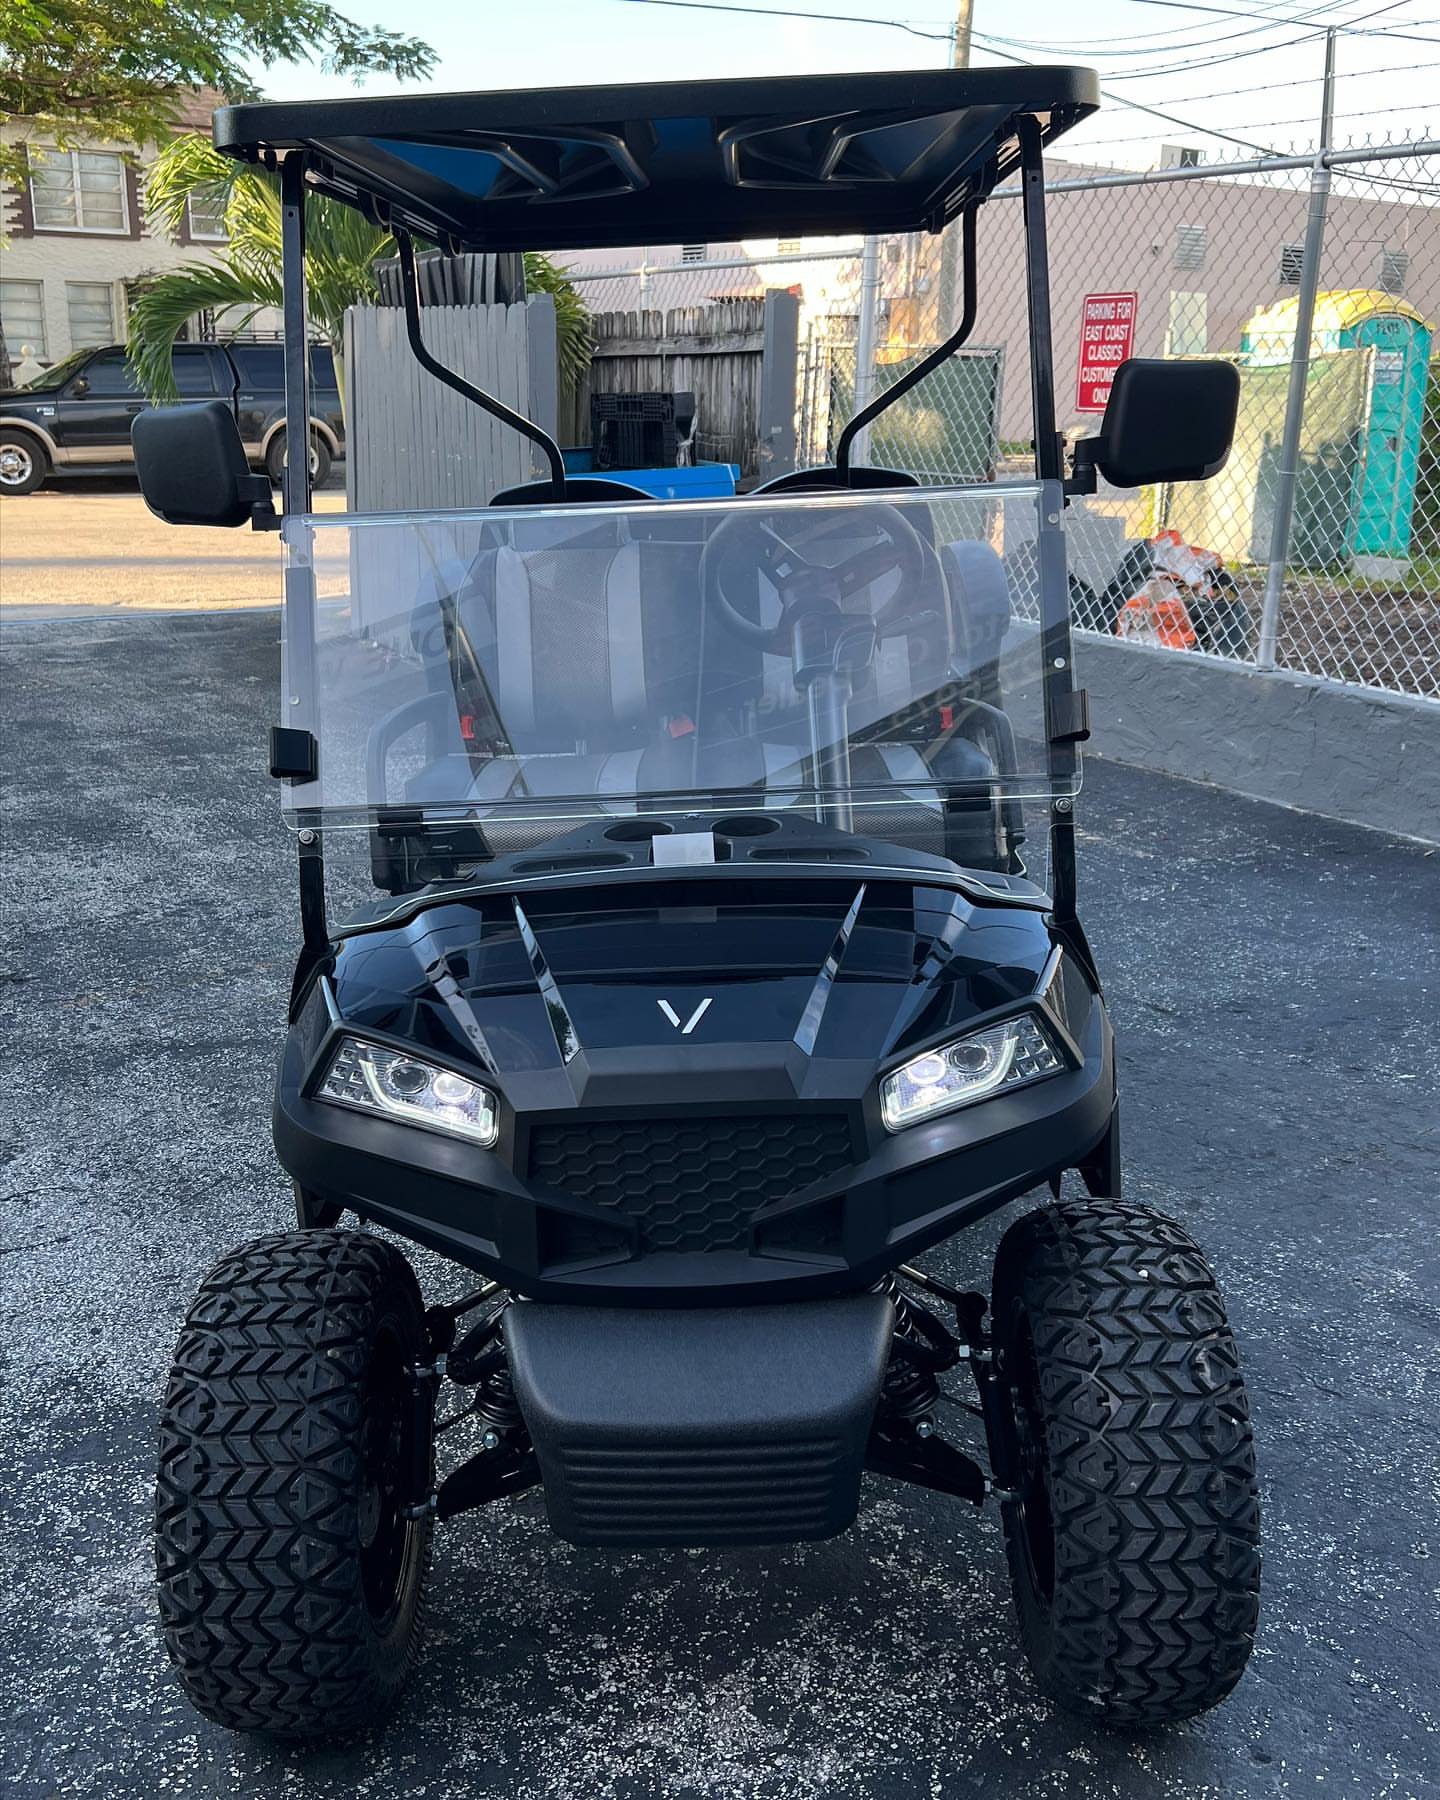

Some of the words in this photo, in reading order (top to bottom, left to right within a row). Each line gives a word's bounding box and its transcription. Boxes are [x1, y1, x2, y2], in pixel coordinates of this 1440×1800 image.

[1087, 303, 1115, 320] PARKING
[1117, 302, 1131, 319] FOR
[1085, 325, 1104, 341] EAST
[1105, 324, 1129, 340] COAST
[1088, 344, 1123, 361] CLASSICS
[1082, 367, 1118, 383] CUSTOME
